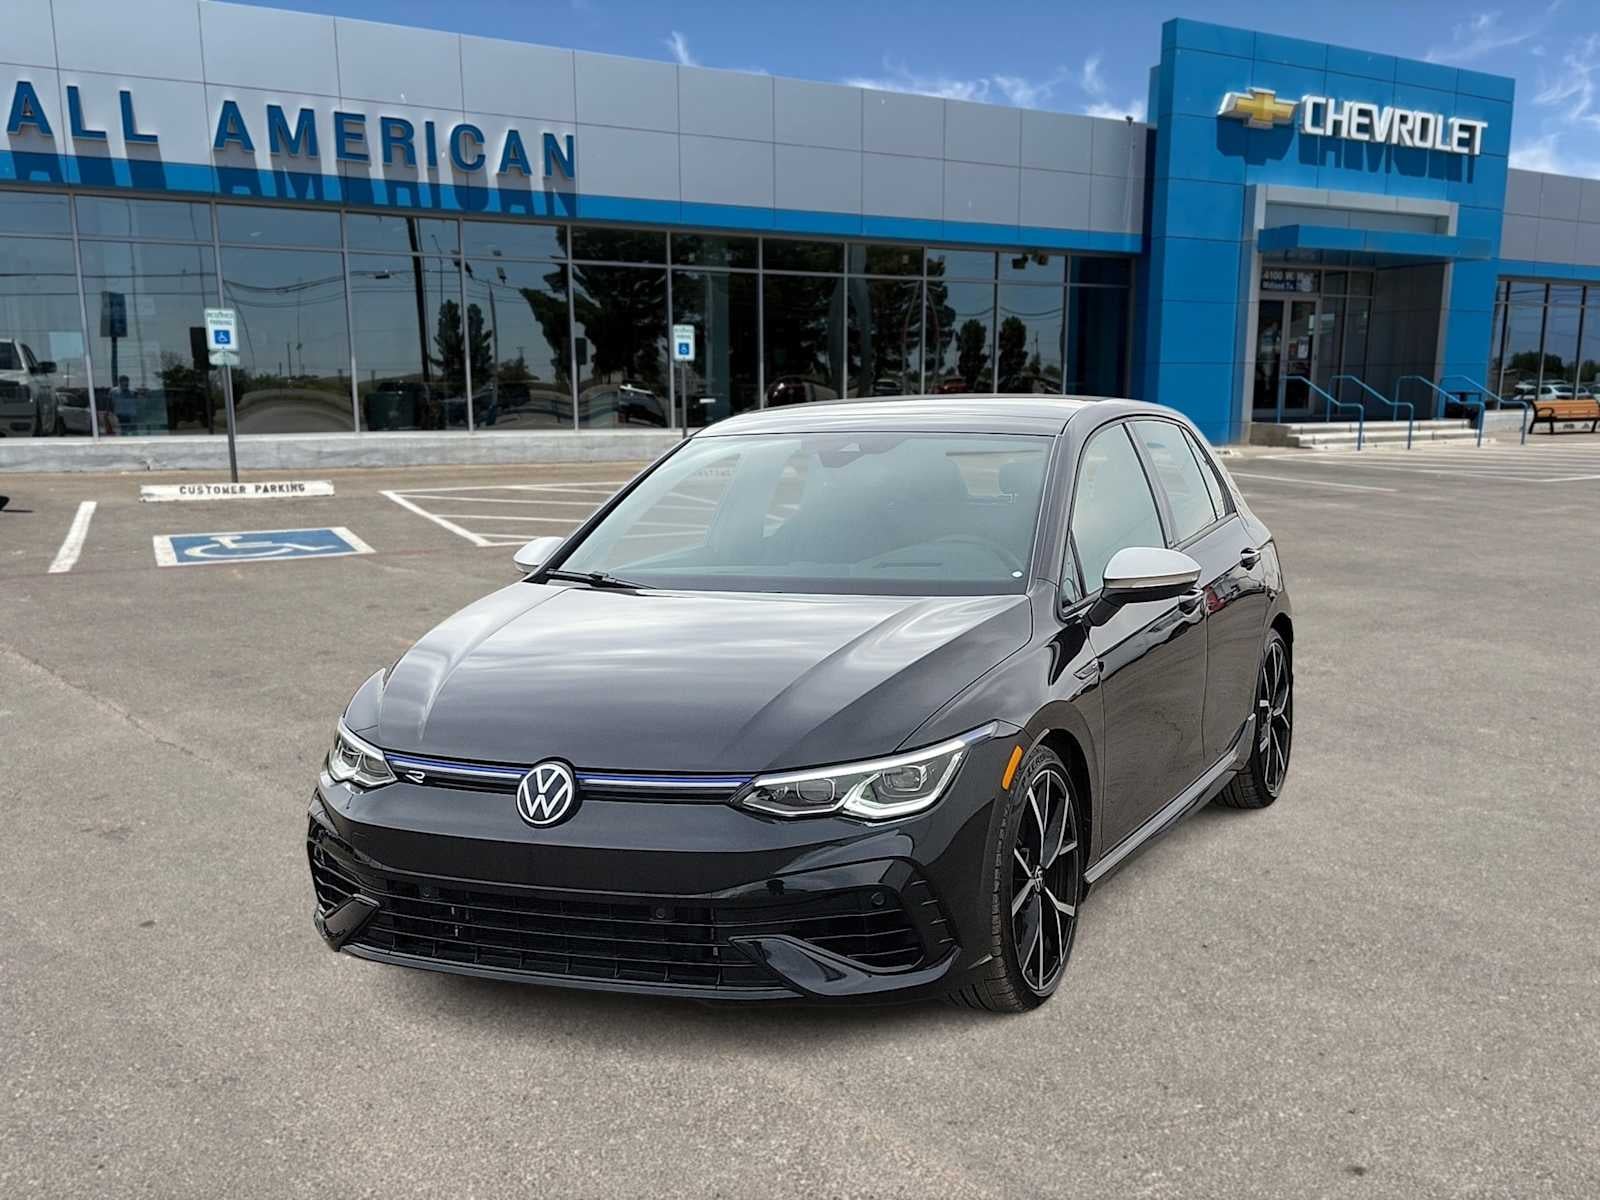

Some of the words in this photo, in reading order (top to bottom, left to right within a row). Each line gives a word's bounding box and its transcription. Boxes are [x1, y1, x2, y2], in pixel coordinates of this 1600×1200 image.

[7, 80, 159, 143] ALL
[213, 100, 576, 179] AMERICAN
[1302, 95, 1488, 155] CHEVROLET
[179, 485, 247, 495] CUSTOMER
[255, 483, 306, 494] PARKING
